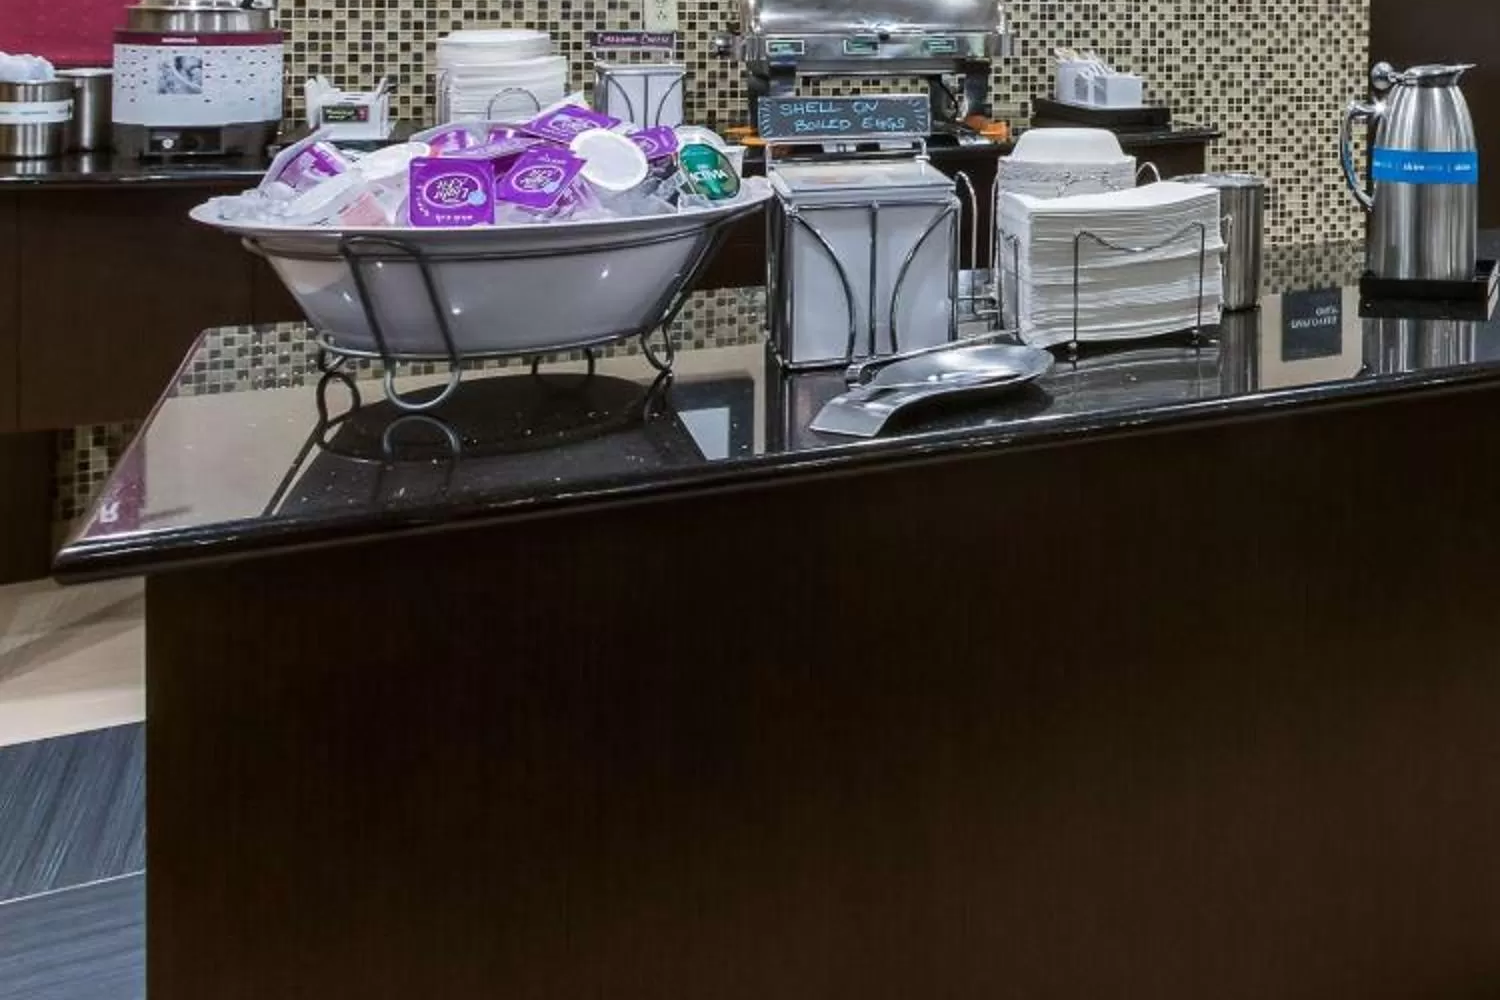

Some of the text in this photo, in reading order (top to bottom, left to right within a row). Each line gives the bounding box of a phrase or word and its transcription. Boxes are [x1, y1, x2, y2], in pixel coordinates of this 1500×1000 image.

[779, 100, 880, 116] SHELL ON
[794, 119, 851, 132] BOILED
